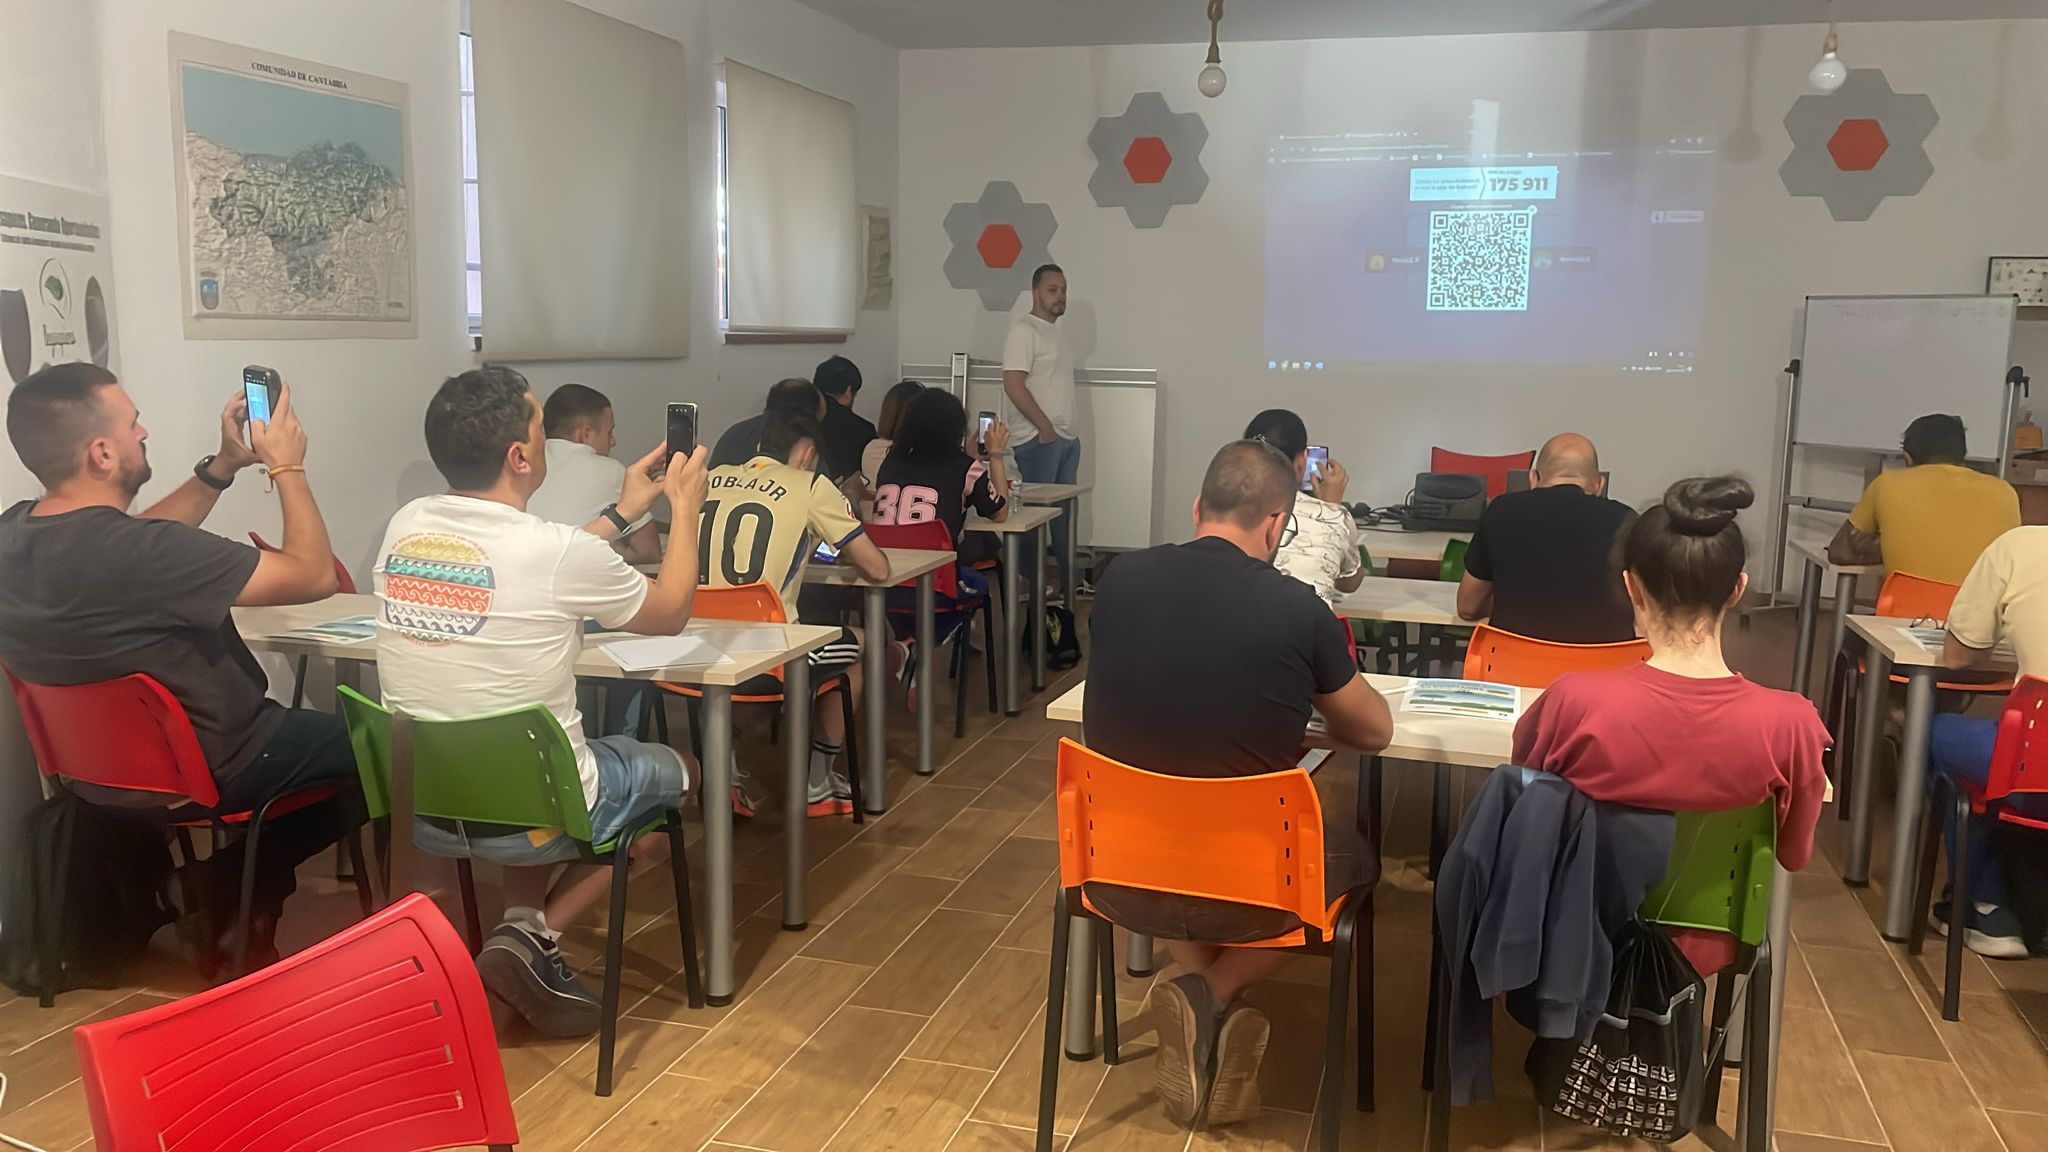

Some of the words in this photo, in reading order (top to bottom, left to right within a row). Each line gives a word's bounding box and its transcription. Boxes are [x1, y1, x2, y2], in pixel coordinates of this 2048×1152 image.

[1489, 177, 1518, 191] 175
[1522, 177, 1549, 191] 911
[709, 475, 788, 502] OBLAJR
[872, 483, 939, 526] 36
[698, 500, 774, 586] 10
